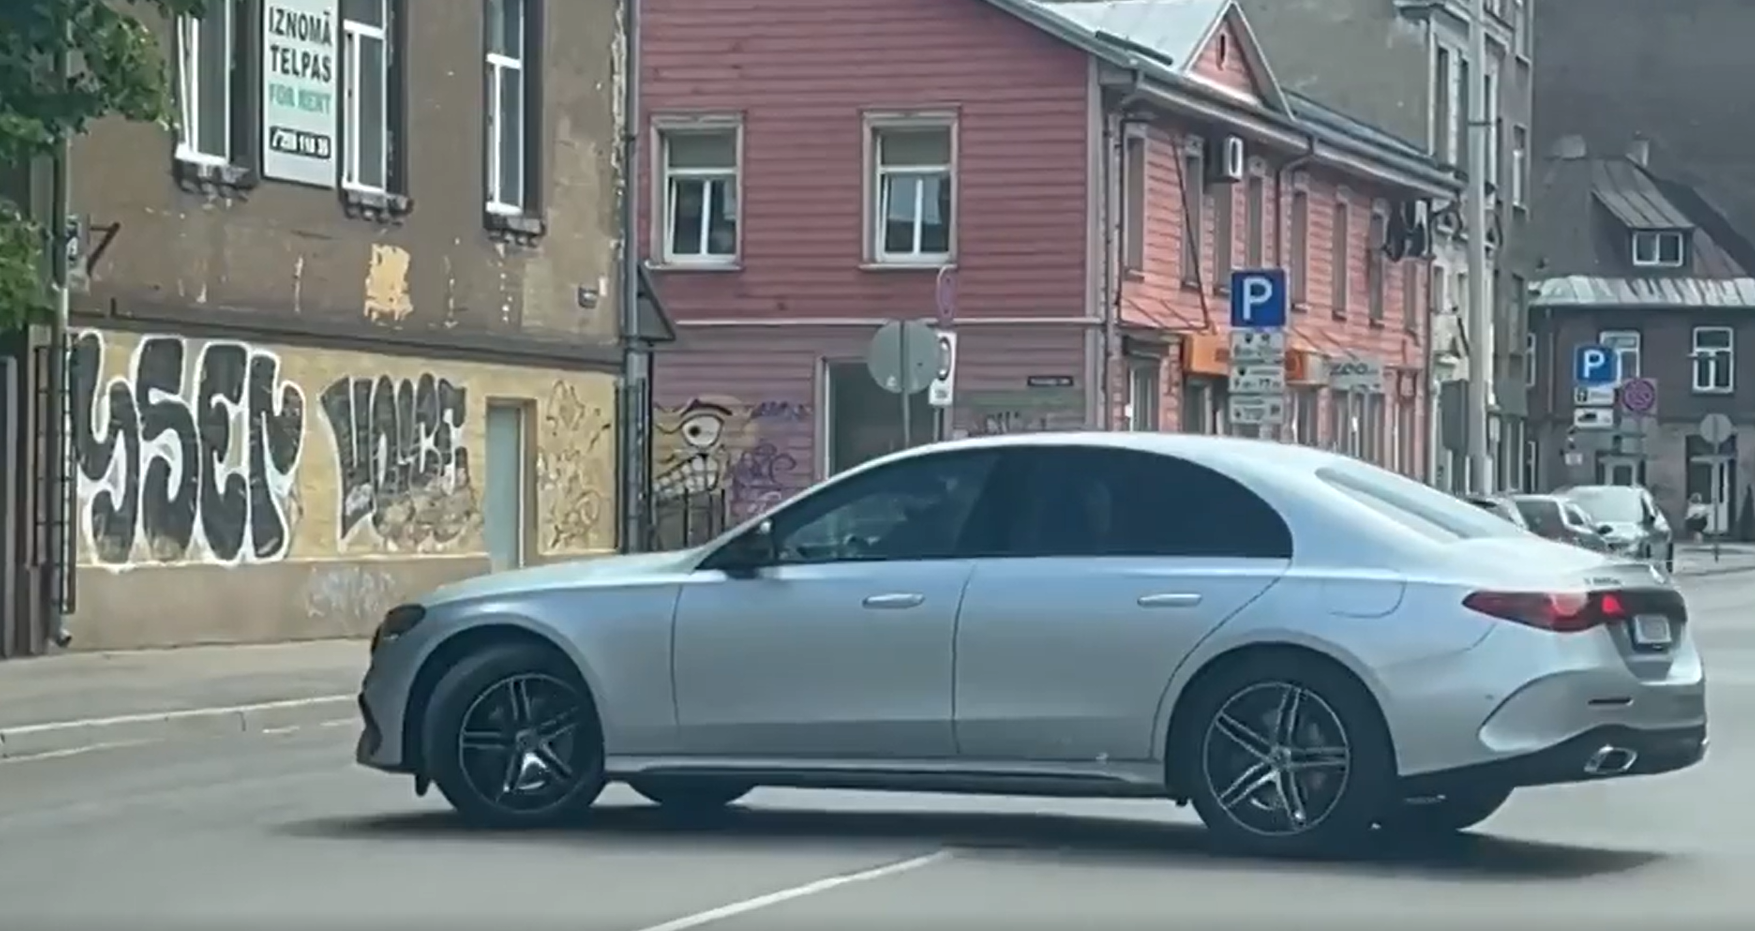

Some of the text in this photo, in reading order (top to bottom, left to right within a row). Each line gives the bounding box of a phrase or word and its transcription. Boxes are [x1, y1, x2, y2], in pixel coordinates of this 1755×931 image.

[269, 6, 333, 46] IZNOMĀ
[270, 44, 332, 83] TELPAS
[1243, 276, 1273, 321] P
[1583, 349, 1606, 378] P
